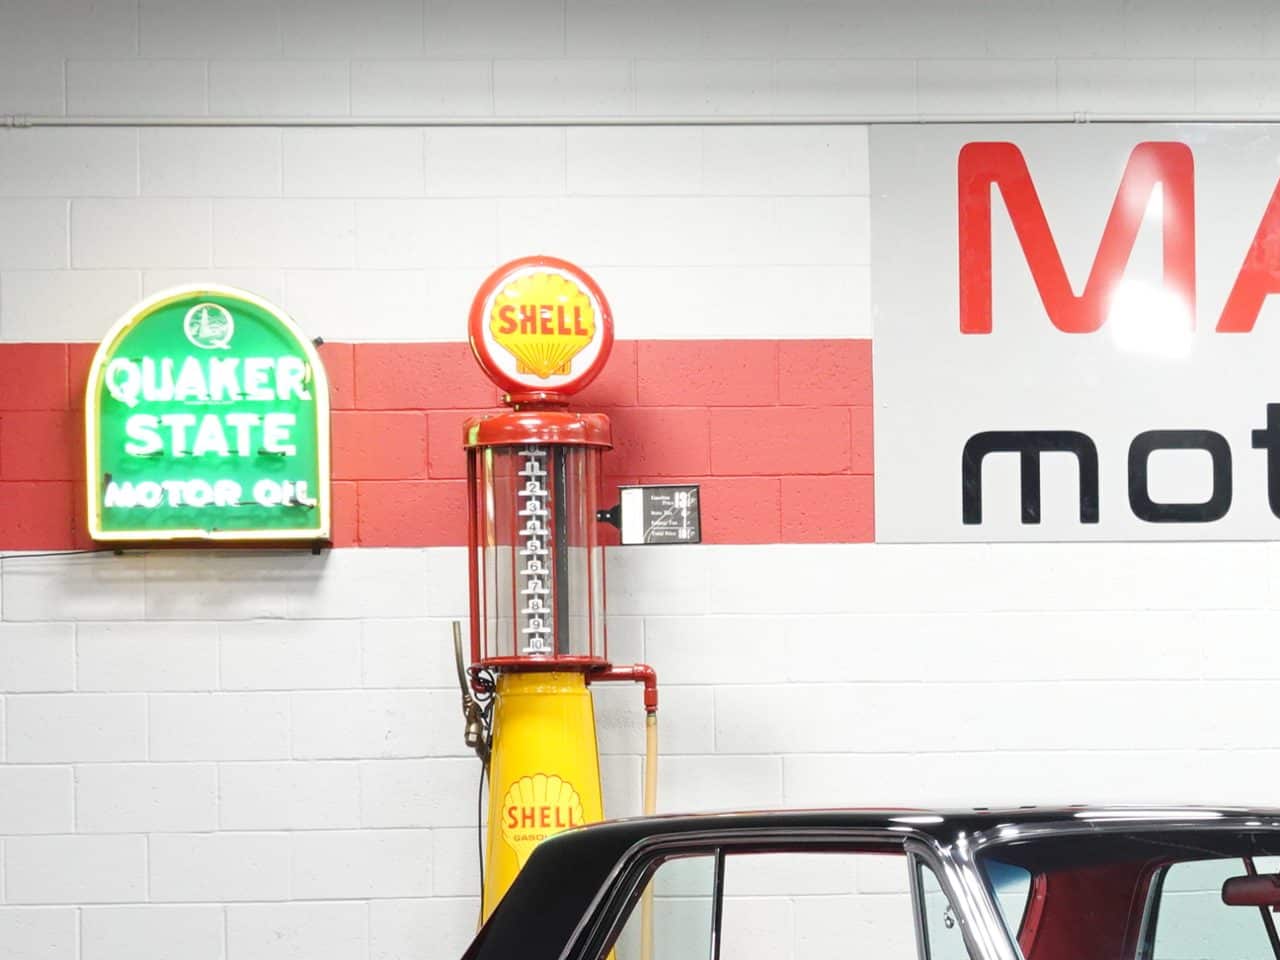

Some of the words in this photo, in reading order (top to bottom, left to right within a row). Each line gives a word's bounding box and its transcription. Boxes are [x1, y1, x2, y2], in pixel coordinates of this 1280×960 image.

[498, 304, 588, 336] SHELL
[104, 355, 313, 408] QUAKER
[124, 412, 297, 457] STATE
[529, 483, 537, 493] 2
[104, 479, 243, 508] MOTOR
[252, 479, 317, 508] OIL
[529, 502, 537, 512] 3
[529, 522, 537, 531] 4
[530, 542, 537, 552] 5
[530, 562, 538, 571] 6
[531, 581, 538, 590] 7
[531, 600, 539, 609] 8
[532, 620, 540, 629] 9
[532, 640, 541, 649] 10
[508, 805, 578, 829] SHELL
